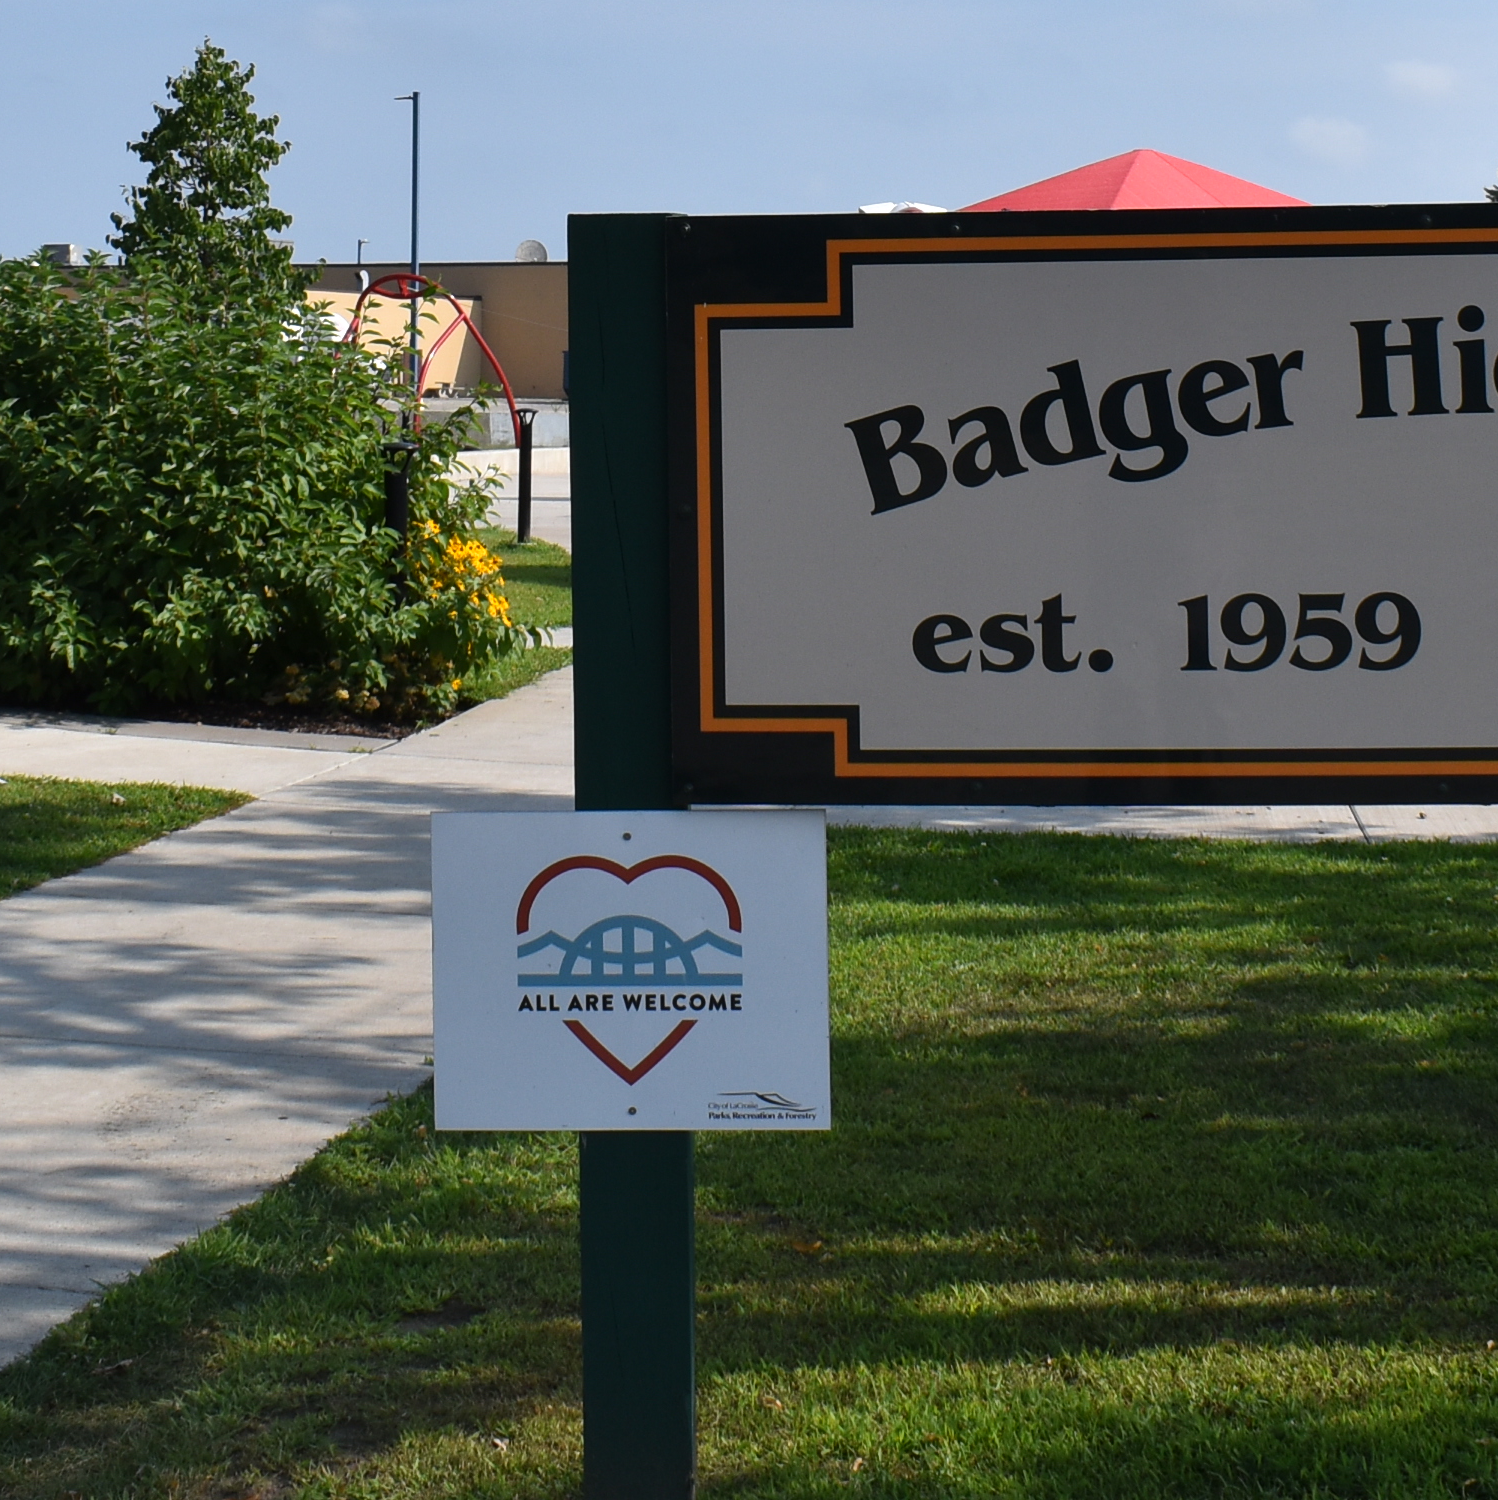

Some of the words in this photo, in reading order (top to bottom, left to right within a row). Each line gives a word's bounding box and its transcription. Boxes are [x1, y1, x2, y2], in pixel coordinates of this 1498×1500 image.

[843, 349, 1305, 516] Badger
[911, 592, 1114, 674] est.
[1177, 591, 1422, 673] 1959
[518, 993, 560, 1012] ALL
[567, 993, 614, 1012] ARE
[622, 993, 743, 1012] WELCOME
[707, 1102, 720, 1111] City
[721, 1101, 729, 1109] of
[785, 1112, 817, 1121] Forestry
